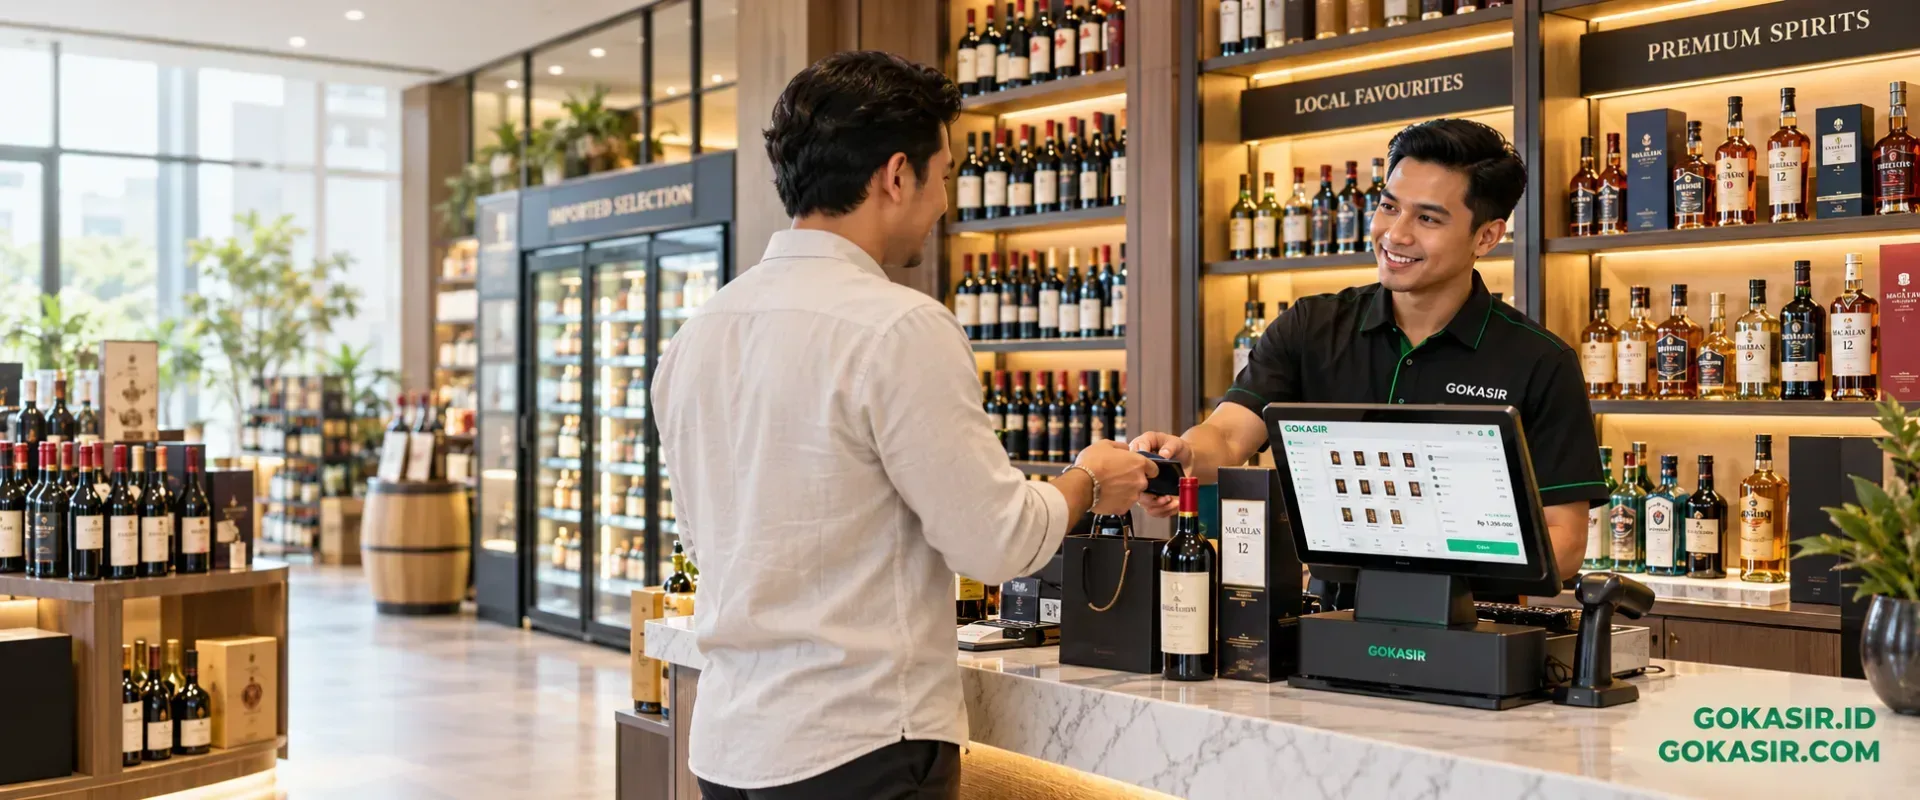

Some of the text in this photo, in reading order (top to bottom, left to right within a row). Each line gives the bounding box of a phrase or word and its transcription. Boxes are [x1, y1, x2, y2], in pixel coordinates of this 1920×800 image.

[1648, 9, 1871, 62] PREMIUM SPIRITS
[1295, 73, 1463, 115] LOCAL FAVOURITES
[1777, 172, 1787, 181] 12
[548, 182, 693, 226] IMPORTED SELECTION
[1843, 340, 1853, 350] 12
[1445, 382, 1508, 400] GOKASIR
[1284, 424, 1328, 434] GOKASIR
[1225, 526, 1261, 535] MACALLAN
[1238, 542, 1249, 554] 12
[1368, 645, 1426, 661] GOKASIR
